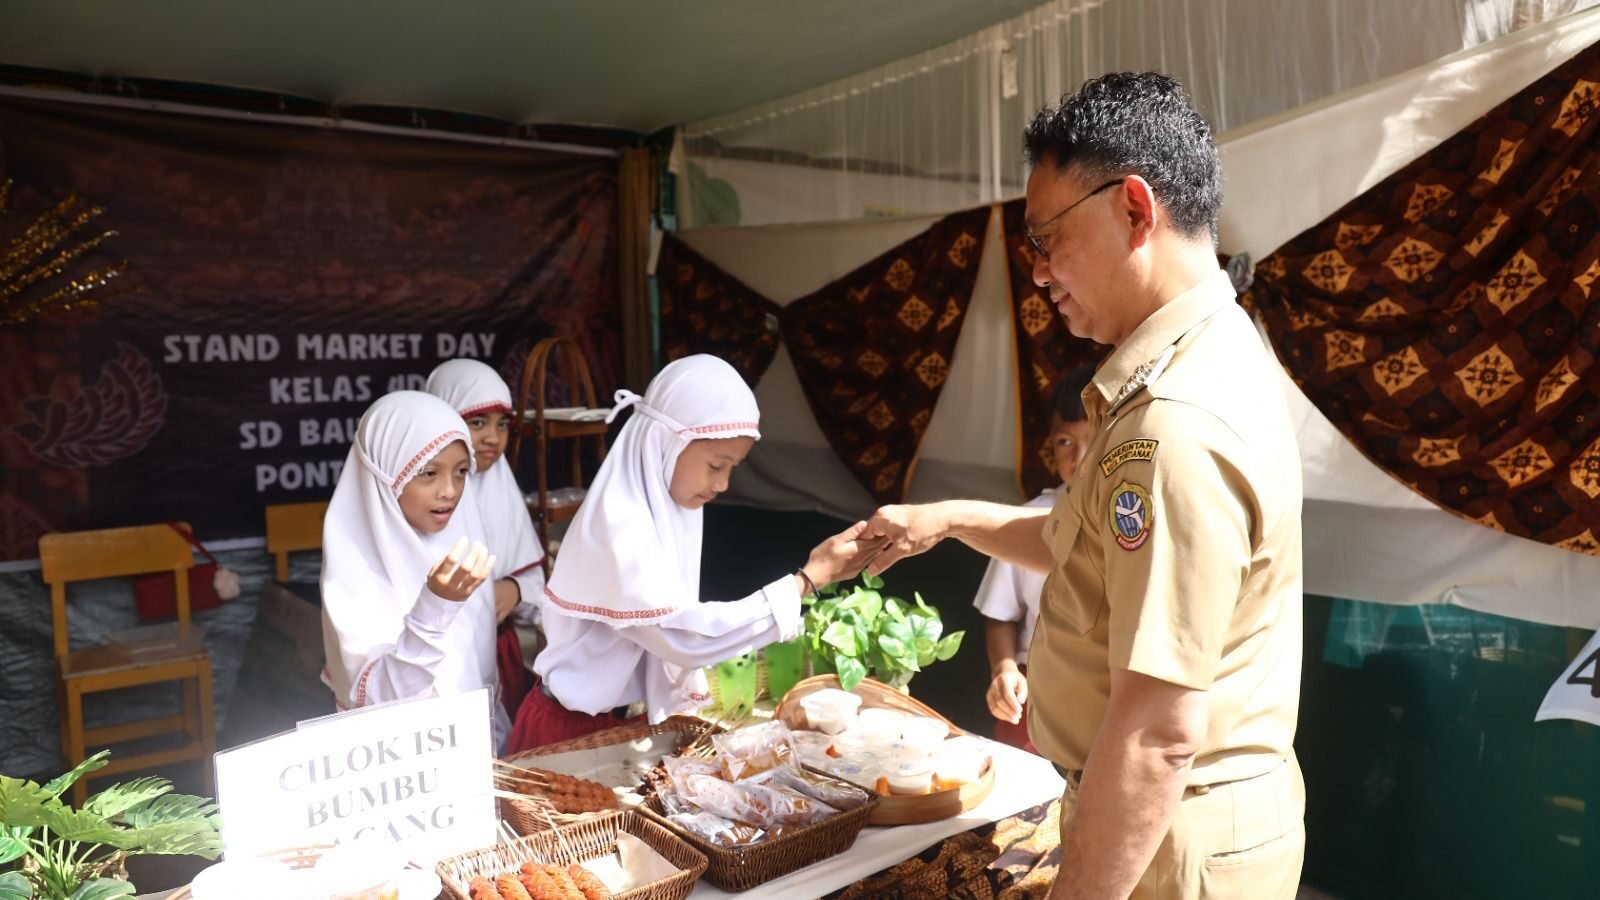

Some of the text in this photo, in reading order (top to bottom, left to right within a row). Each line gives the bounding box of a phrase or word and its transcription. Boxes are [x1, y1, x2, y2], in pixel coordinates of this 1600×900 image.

[163, 333, 496, 363] STAND MARKET DAY
[270, 375, 371, 404] KELAS
[239, 421, 282, 449] SD
[1102, 441, 1154, 465] PEMERINTAH
[279, 724, 458, 792] CILOK ISI
[307, 768, 439, 828] BUMBU
